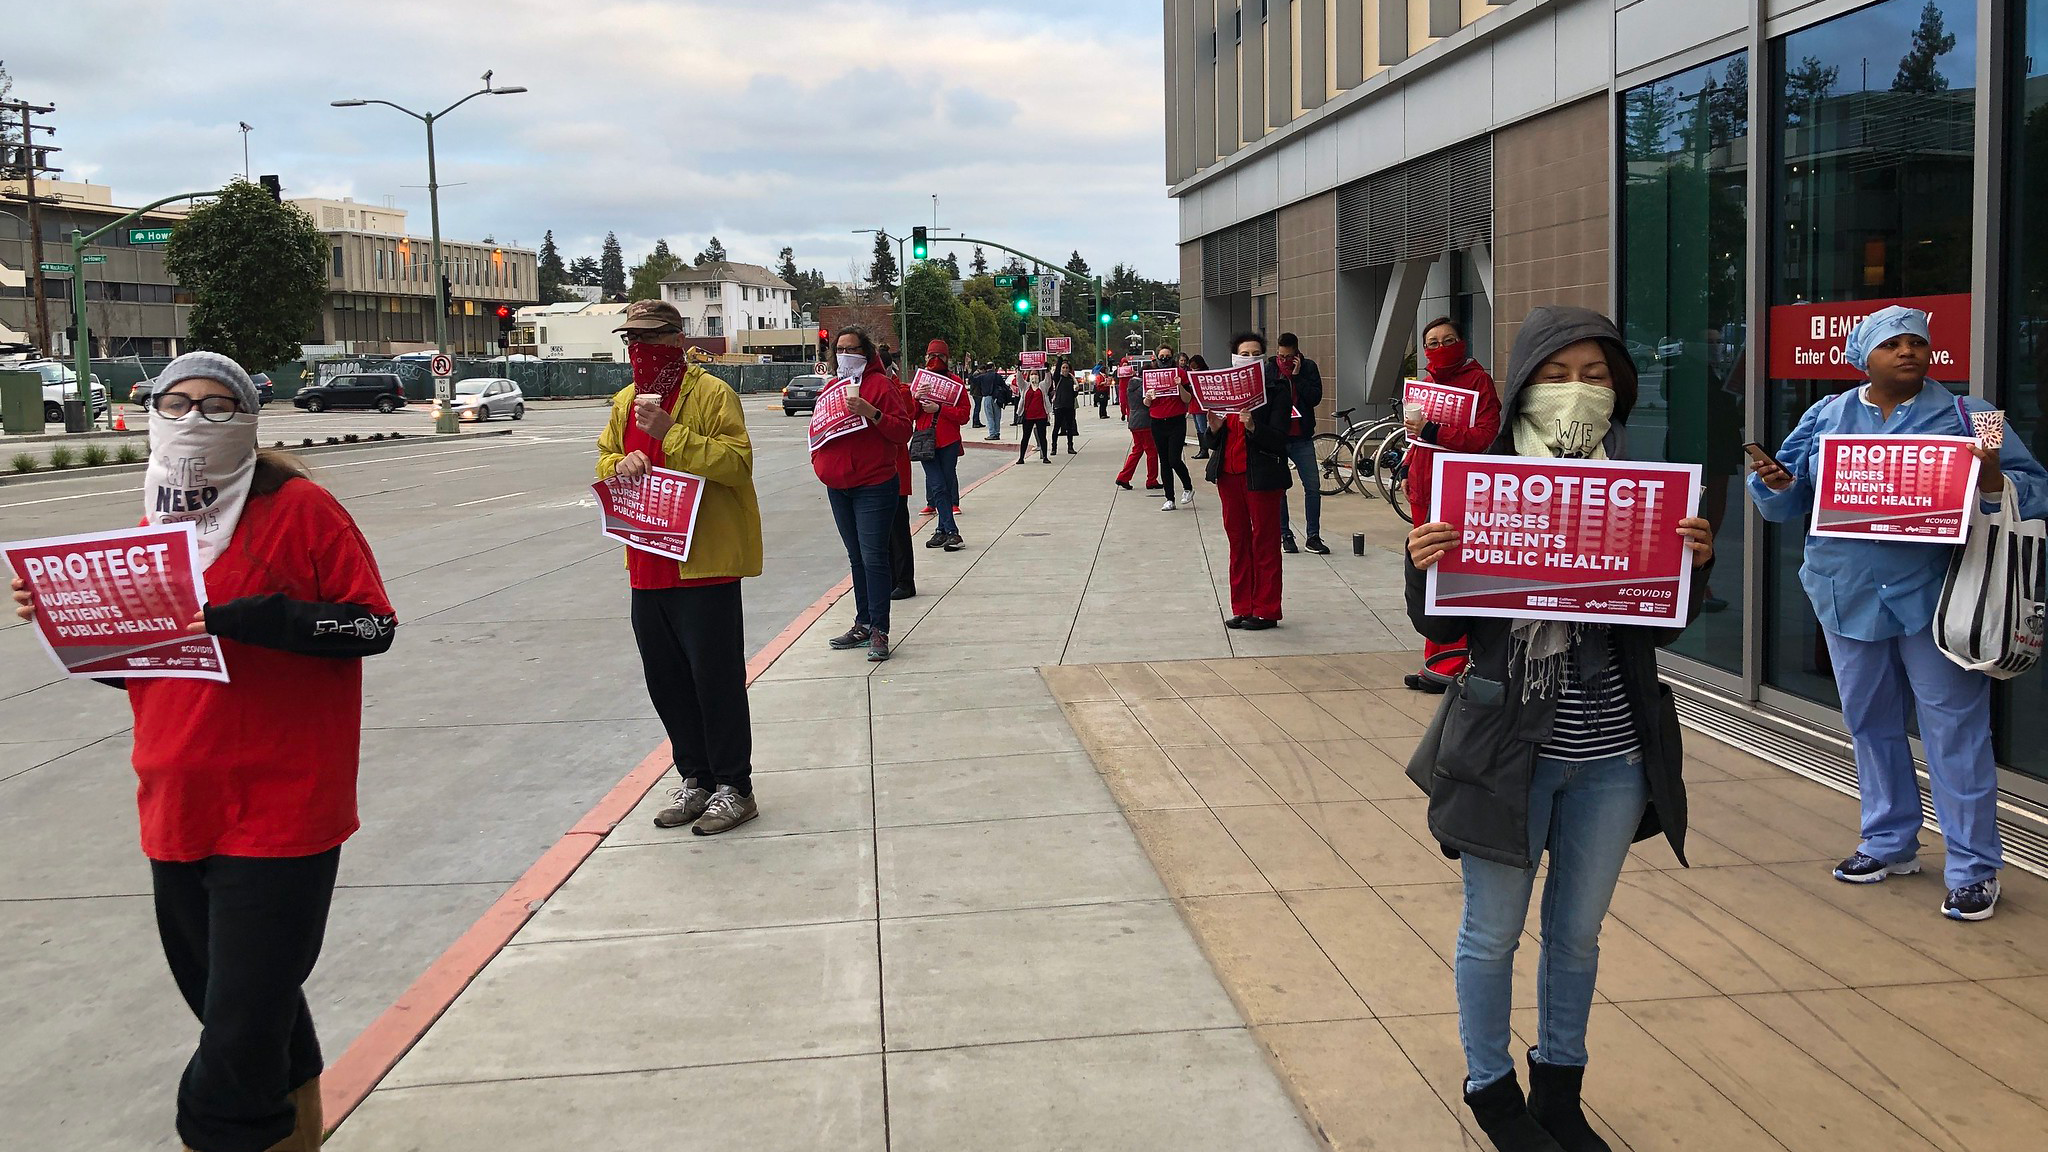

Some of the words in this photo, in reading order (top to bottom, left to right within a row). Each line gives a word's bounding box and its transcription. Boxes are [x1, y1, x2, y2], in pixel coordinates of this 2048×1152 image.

[1795, 347, 1825, 365] Enter
[921, 372, 957, 389] PROTECT
[1197, 367, 1254, 384] PROTECT
[1226, 391, 1251, 401] HEALTH
[1408, 386, 1466, 408] PROTECT
[1555, 419, 1593, 454] WE
[1836, 445, 1958, 465] PROTECT
[163, 456, 208, 488] WE
[1835, 470, 1885, 481] NURSES
[609, 488, 640, 500] NURSES
[1465, 471, 1665, 508] PROTECT
[1834, 482, 1895, 493] PATIENTS
[156, 485, 219, 513] NEED
[612, 496, 645, 512] PATIENTS
[1833, 494, 1878, 505] PUBLIC
[1881, 495, 1932, 507] HEALTH
[613, 504, 635, 519] PUBLIC
[636, 512, 669, 528] HEALTH
[1463, 511, 1550, 529] NURSES
[1925, 517, 1959, 525] #COVID19
[1462, 530, 1567, 549] PATIENTS
[23, 543, 169, 585] PROTECT
[1461, 549, 1538, 567] PUBLIC
[1544, 552, 1629, 571] HEALTH
[39, 589, 102, 607] NURSES
[1618, 588, 1672, 599] #COVID19
[48, 605, 123, 623] PATIENTS
[56, 621, 114, 639] PUBLIC
[115, 617, 178, 635] HEALTH
[181, 645, 214, 654] #COVID19
